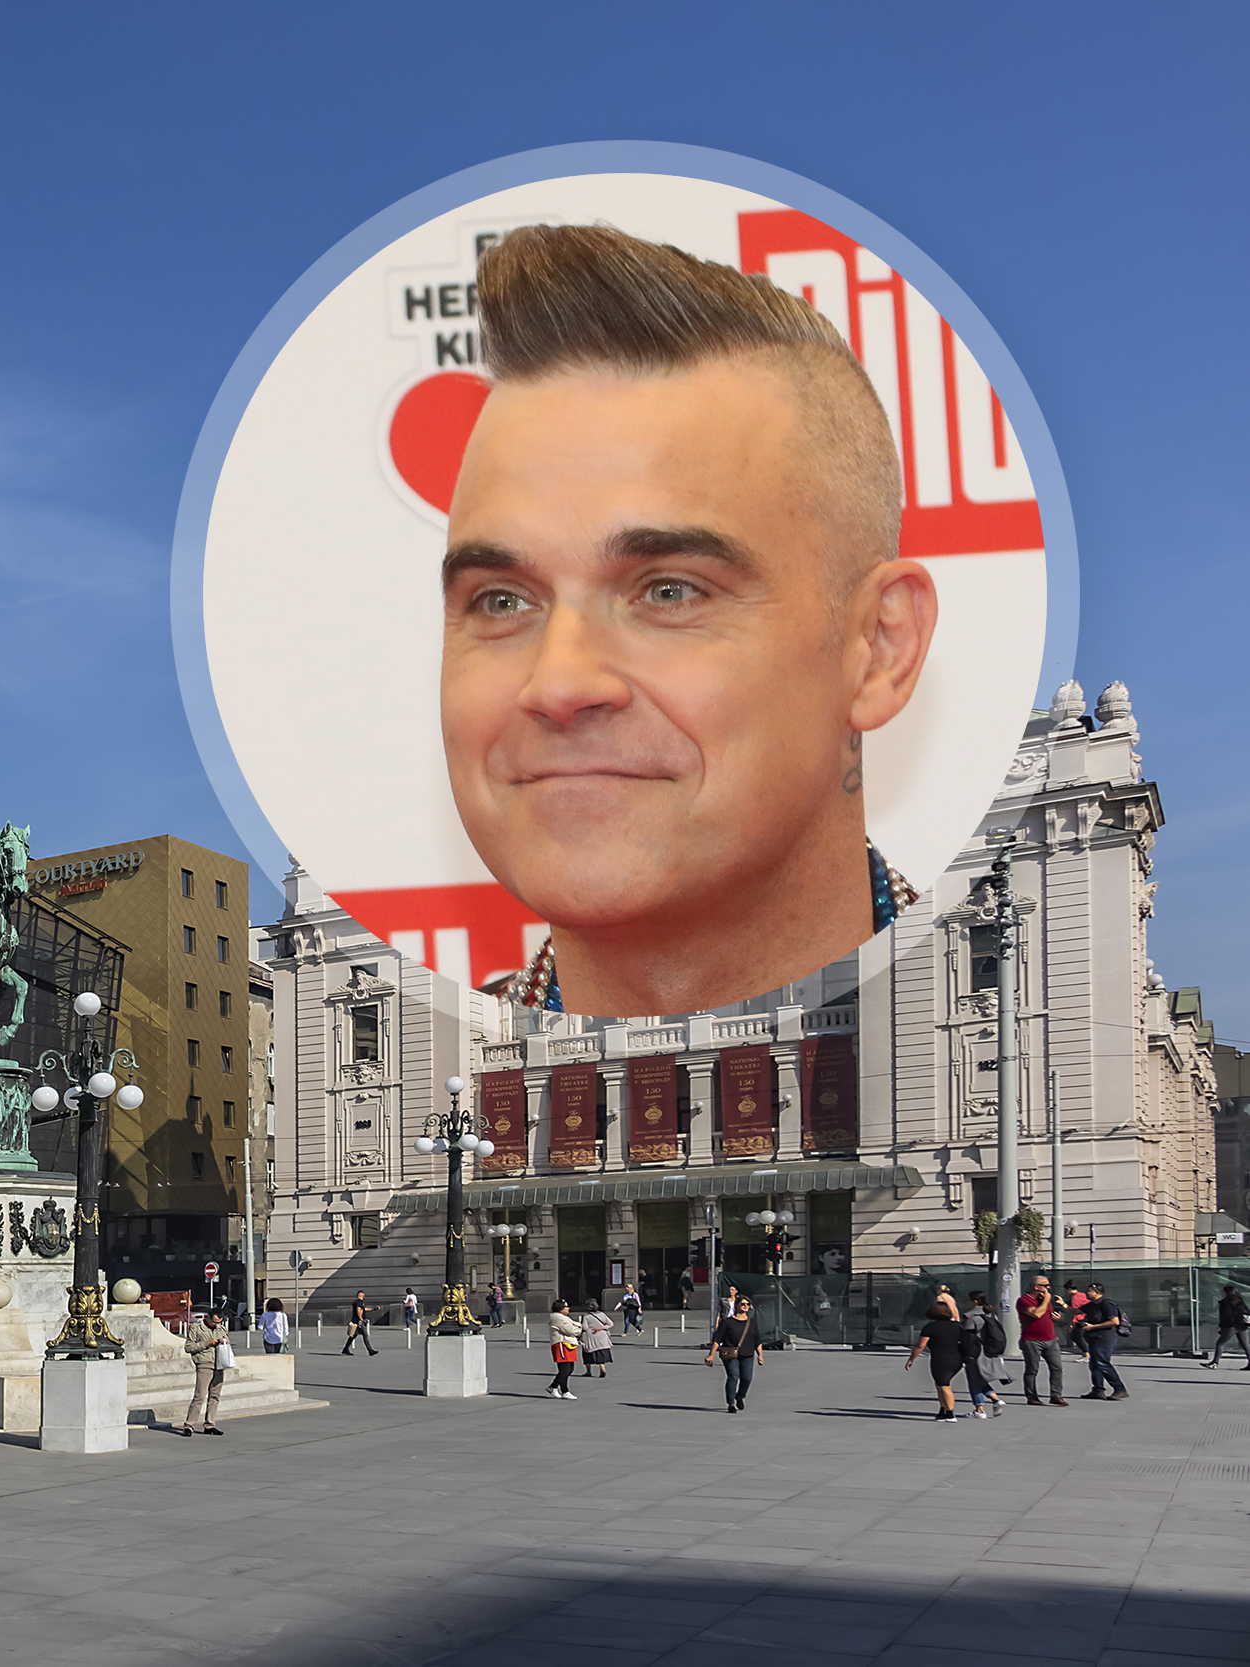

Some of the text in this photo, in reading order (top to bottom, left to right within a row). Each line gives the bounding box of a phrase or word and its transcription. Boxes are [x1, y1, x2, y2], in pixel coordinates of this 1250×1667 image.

[739, 1079, 755, 1087] 150
[646, 1087, 661, 1095] 150
[1221, 1233, 1237, 1241] WC
